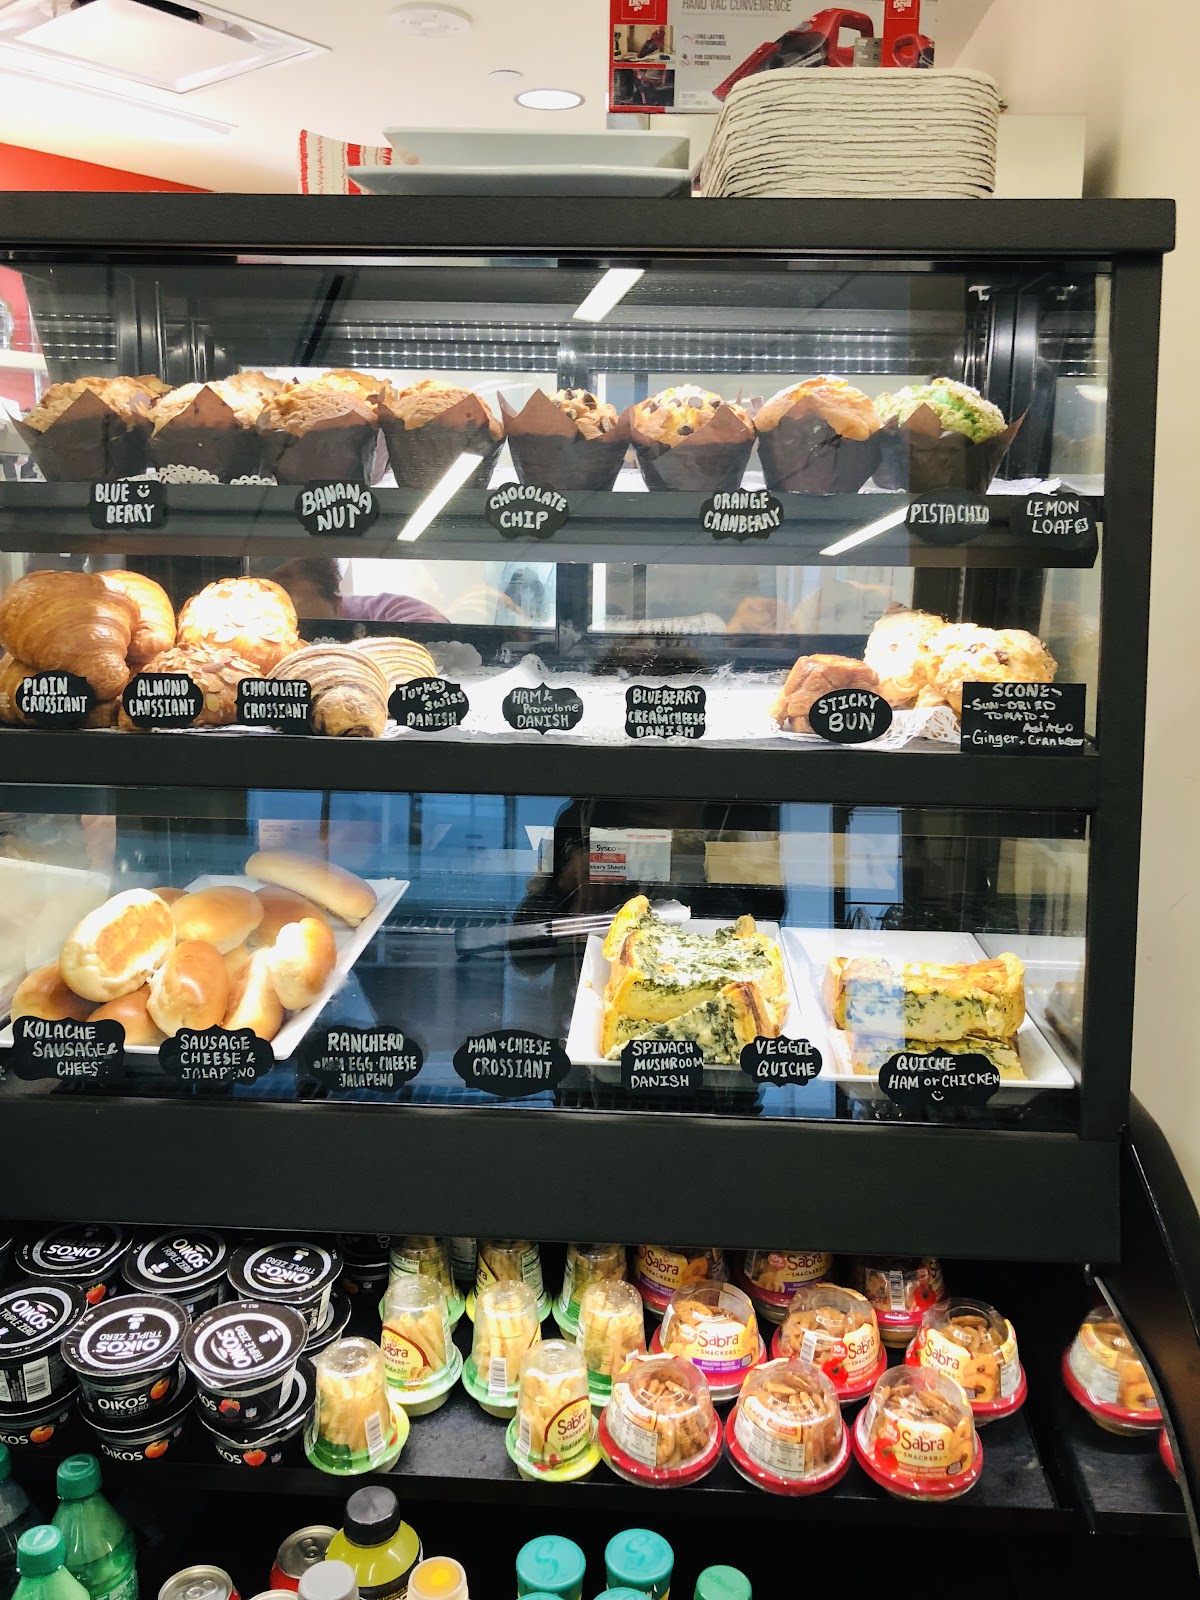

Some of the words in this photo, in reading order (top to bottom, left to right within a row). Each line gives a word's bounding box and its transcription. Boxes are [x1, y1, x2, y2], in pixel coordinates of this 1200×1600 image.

[729, 0, 792, 12] CONVENIENCE
[95, 483, 129, 503] BLUE
[302, 482, 372, 516] BANANA
[489, 485, 568, 512] CHOCOLATE
[713, 491, 770, 510] ORANGE
[106, 504, 155, 524] BERRY
[317, 504, 361, 531] NUT
[909, 503, 990, 525] PISTACHIO
[1026, 500, 1080, 518] LEMON
[500, 510, 549, 530] CHIP
[703, 507, 780, 533] CRANBERRY
[1031, 519, 1074, 534] LOAF
[23, 676, 68, 696] PLAIN
[137, 679, 190, 697] ALMOND
[242, 681, 308, 698] CHOCOLATE
[399, 680, 446, 701] Turkey
[22, 696, 88, 714] CROSSIANT
[512, 690, 542, 704] HAM
[632, 688, 702, 705] BLUEBERRY
[818, 694, 879, 714] STICKY
[128, 699, 196, 718] CROSSIANT
[243, 702, 309, 720] CROSSIANT
[406, 711, 457, 727] DANISH
[517, 714, 569, 728] DANISH
[828, 712, 876, 733] BUN
[636, 725, 695, 738] DANISH
[596, 844, 617, 853] Sysco
[23, 1020, 96, 1040] KOLACHE
[180, 1034, 251, 1051] SAUSAGE
[327, 1032, 404, 1053] RANCHERO
[467, 1037, 498, 1055] HAM
[632, 1041, 694, 1057] SPINACH
[756, 1040, 814, 1056] VEGGIE
[180, 1051, 241, 1066] CHEESE
[349, 1056, 374, 1072] EGG
[633, 1056, 705, 1072] MUSHROOM
[896, 1055, 957, 1072] QUICHE
[56, 1061, 104, 1077] CHEES
[181, 1067, 256, 1080] JALAPNO
[472, 1057, 552, 1079] CROSSIANT
[756, 1060, 816, 1078] QUICHE
[630, 1074, 689, 1090] DANISH
[888, 1074, 919, 1090] HAM
[941, 1072, 1000, 1088] CHICKEN
[46, 1244, 102, 1258] OIKOS
[161, 1244, 181, 1263] TRIPLE
[175, 1258, 194, 1274] ZERO
[172, 1239, 209, 1269] OIKOS
[265, 1256, 289, 1268] ZERO
[287, 1263, 316, 1275] TRIPLE
[646, 1249, 679, 1276] Sabra
[787, 1252, 822, 1271] Sabra
[256, 1263, 310, 1284] OIKOS
[0, 1308, 23, 1328] TRIPLE
[18, 1319, 38, 1337] ZERO
[11, 1300, 52, 1330] OIKOS
[99, 1332, 127, 1341] ZERO
[127, 1330, 162, 1340] TRIPLE
[234, 1325, 250, 1346] ZERO
[697, 1330, 739, 1348] Sabra
[95, 1339, 161, 1353] OIKOS
[216, 1329, 252, 1368] OIKOS
[700, 1348, 737, 1356] SNACKERS
[848, 1336, 875, 1360] Sabra
[925, 1339, 960, 1370] Sabra
[97, 1393, 148, 1410] OIKOS
[557, 1408, 587, 1435] Sabra
[901, 1430, 945, 1453] Sabra
[101, 1443, 144, 1461] OIKOS
[903, 1451, 943, 1461] SNACKERS
